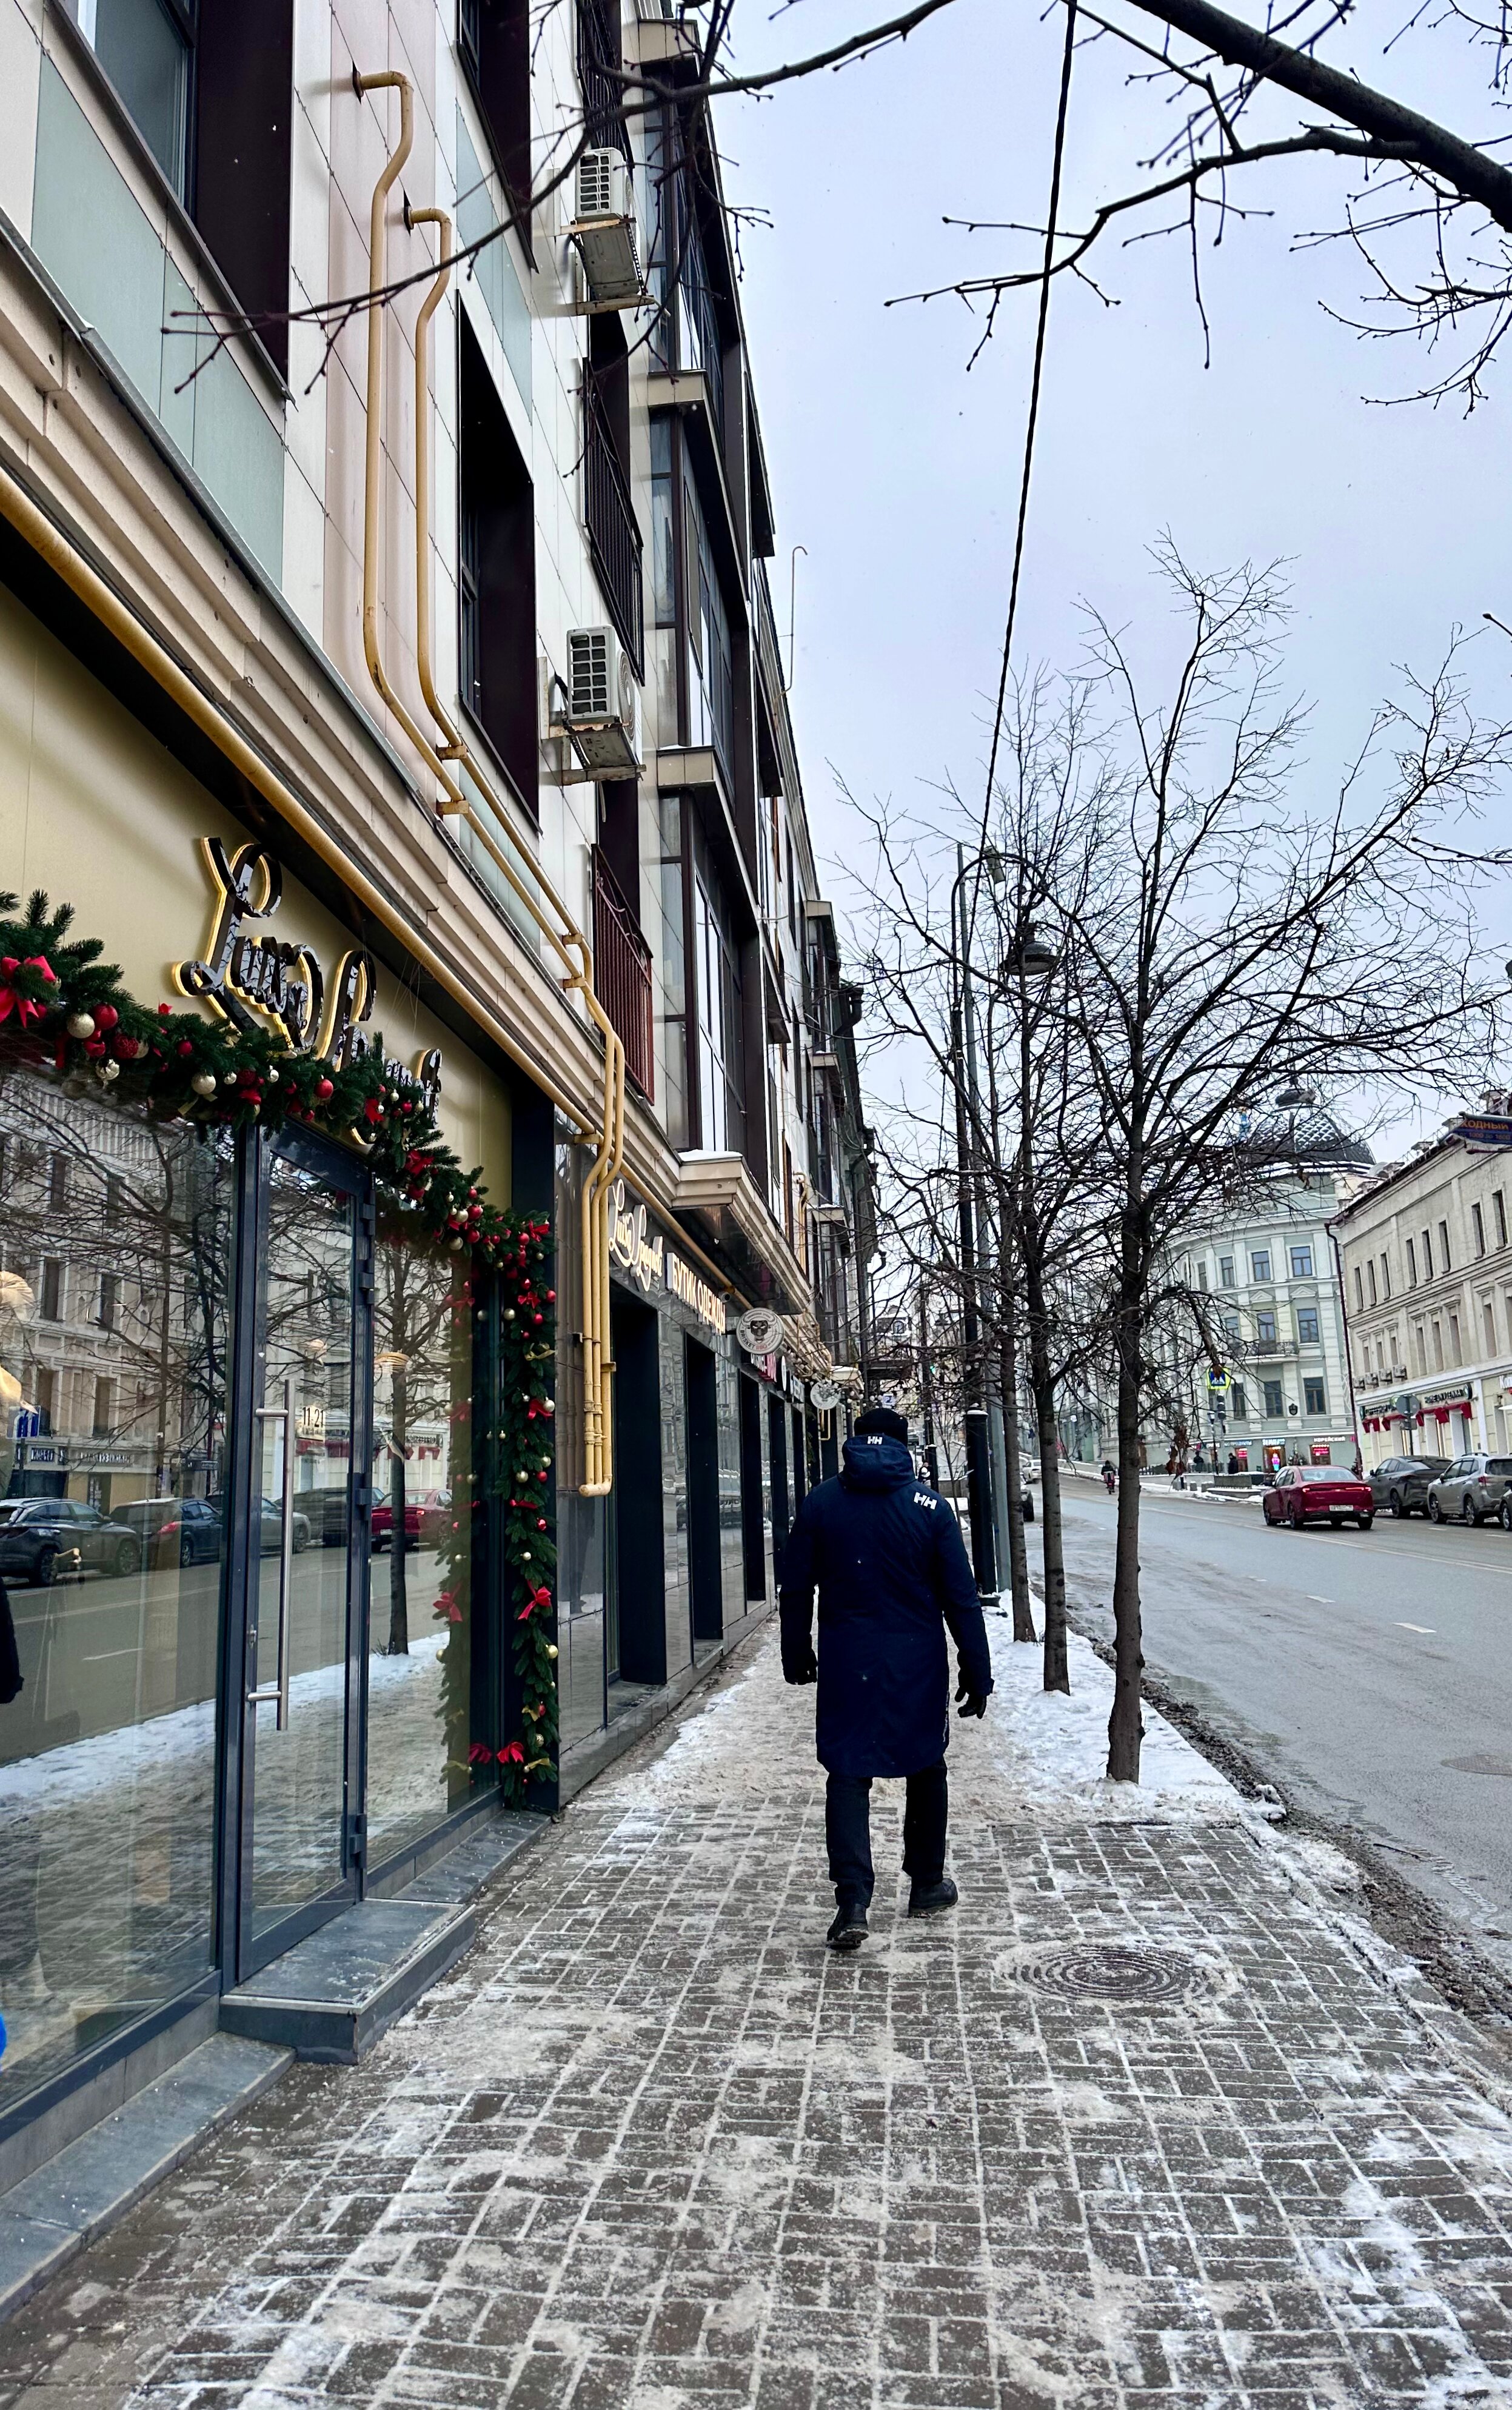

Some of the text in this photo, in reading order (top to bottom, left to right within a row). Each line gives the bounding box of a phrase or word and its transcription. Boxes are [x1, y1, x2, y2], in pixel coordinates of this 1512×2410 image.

[672, 1254, 726, 1336] БУТИК ОДЕЖДЫ
[740, 1330, 755, 1349] BRISKET
[867, 1436, 882, 1445] HH
[914, 1491, 937, 1510] HH
